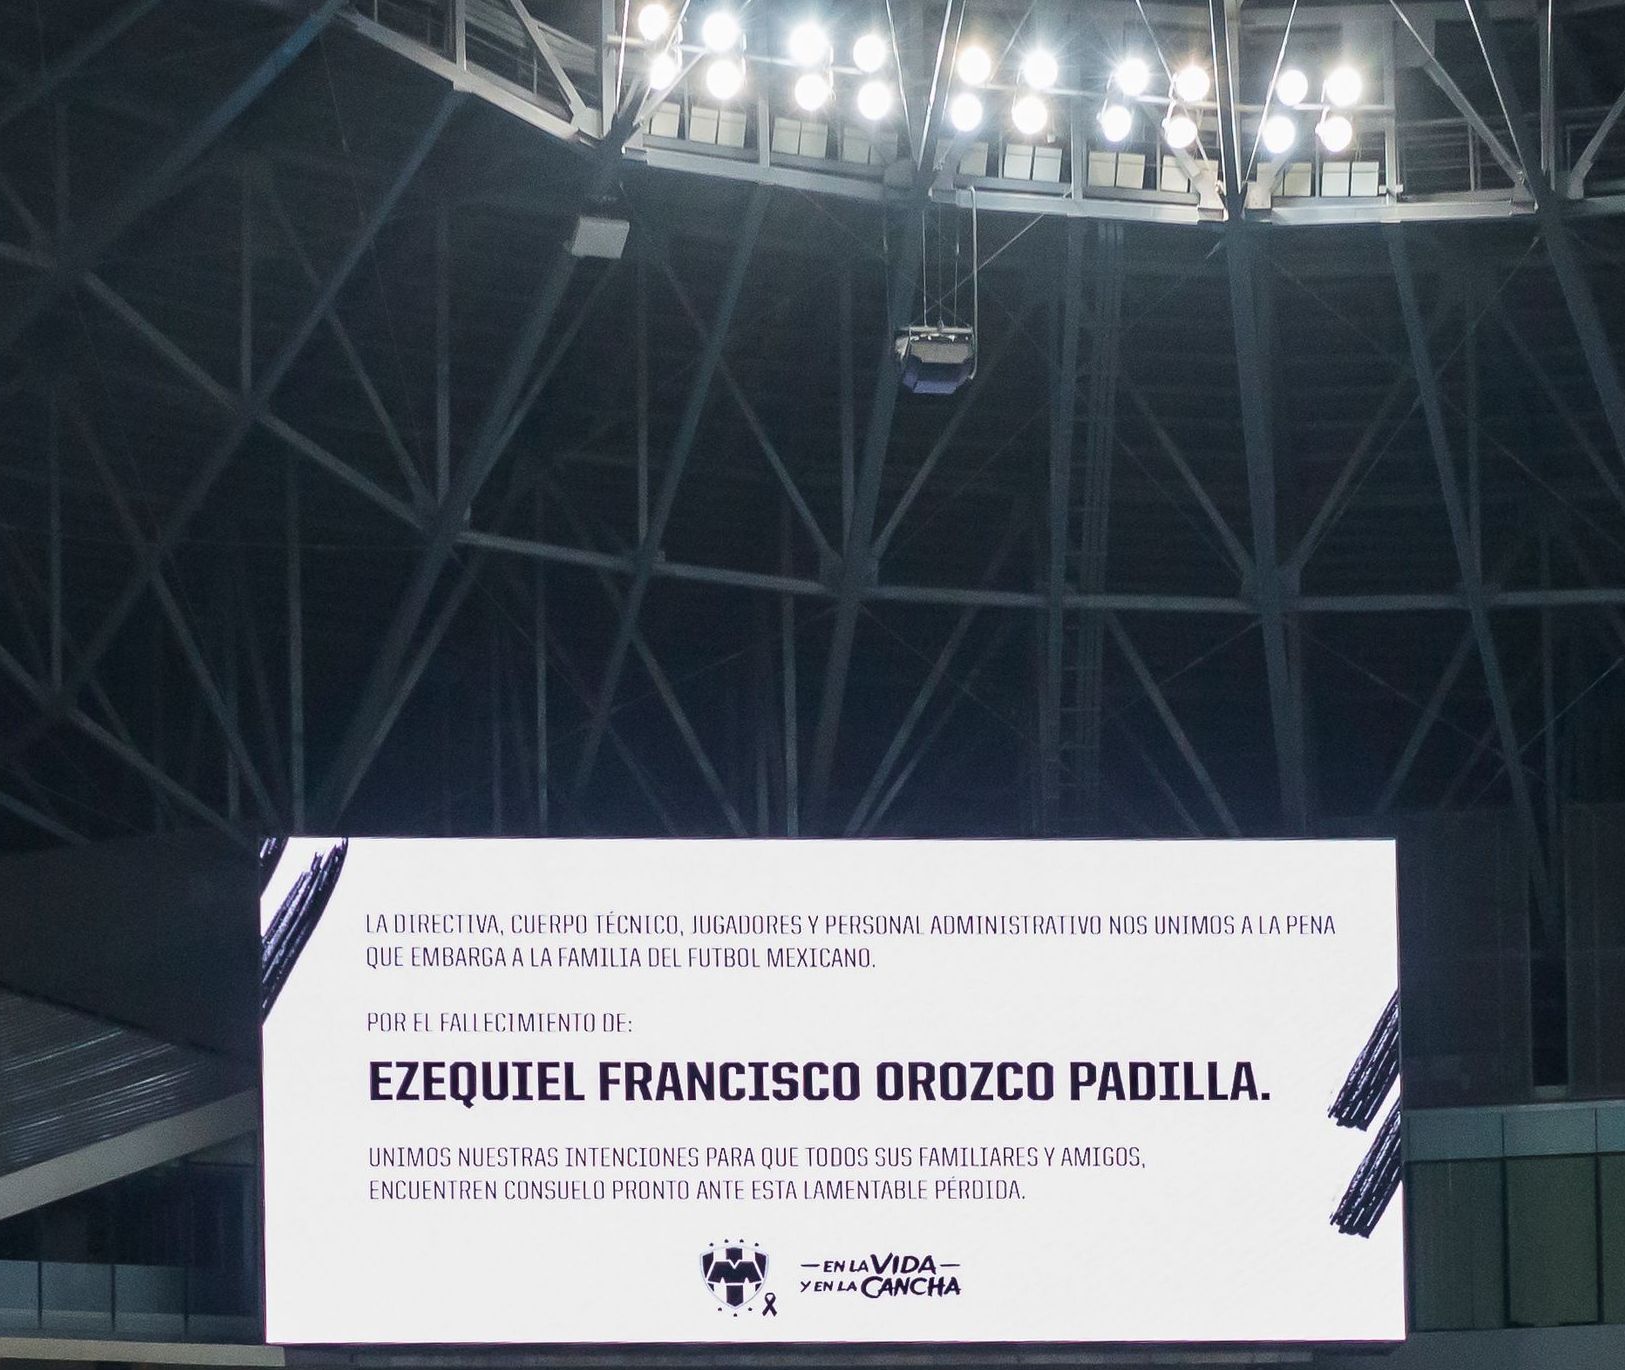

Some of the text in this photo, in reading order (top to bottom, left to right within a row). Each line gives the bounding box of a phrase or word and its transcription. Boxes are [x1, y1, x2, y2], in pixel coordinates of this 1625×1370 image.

[366, 910, 1336, 937] LA DIRECTIVA, CUERPO TÉCNICO, JUGADORES Y PERSONAL ADMINISTRATIVO NOS UNIMOS A LA PENA
[366, 946, 876, 970] QUE EMBARGA A LA FAMILIA DEL FUTBOL MEXICANO.
[367, 1012, 632, 1033] POR EL FALLECIMIENTO DE:
[369, 1061, 1271, 1109] EZEQUIEL FRANCISCO OROZCO PADILLA.
[369, 1146, 1146, 1170] UNIMOS NUESTRAS INTENCIONES PARA QUE TODOS SUS FAMILIARES Y AMIGOS,
[369, 1175, 1026, 1200] ENCUENTREN CONSUELO PRONTO ANTE ESTA LAMENTABLE PÉRDIDA.
[823, 1252, 937, 1275] EN LA VIDA
[800, 1276, 961, 1298] Y EN LA CANCHA
